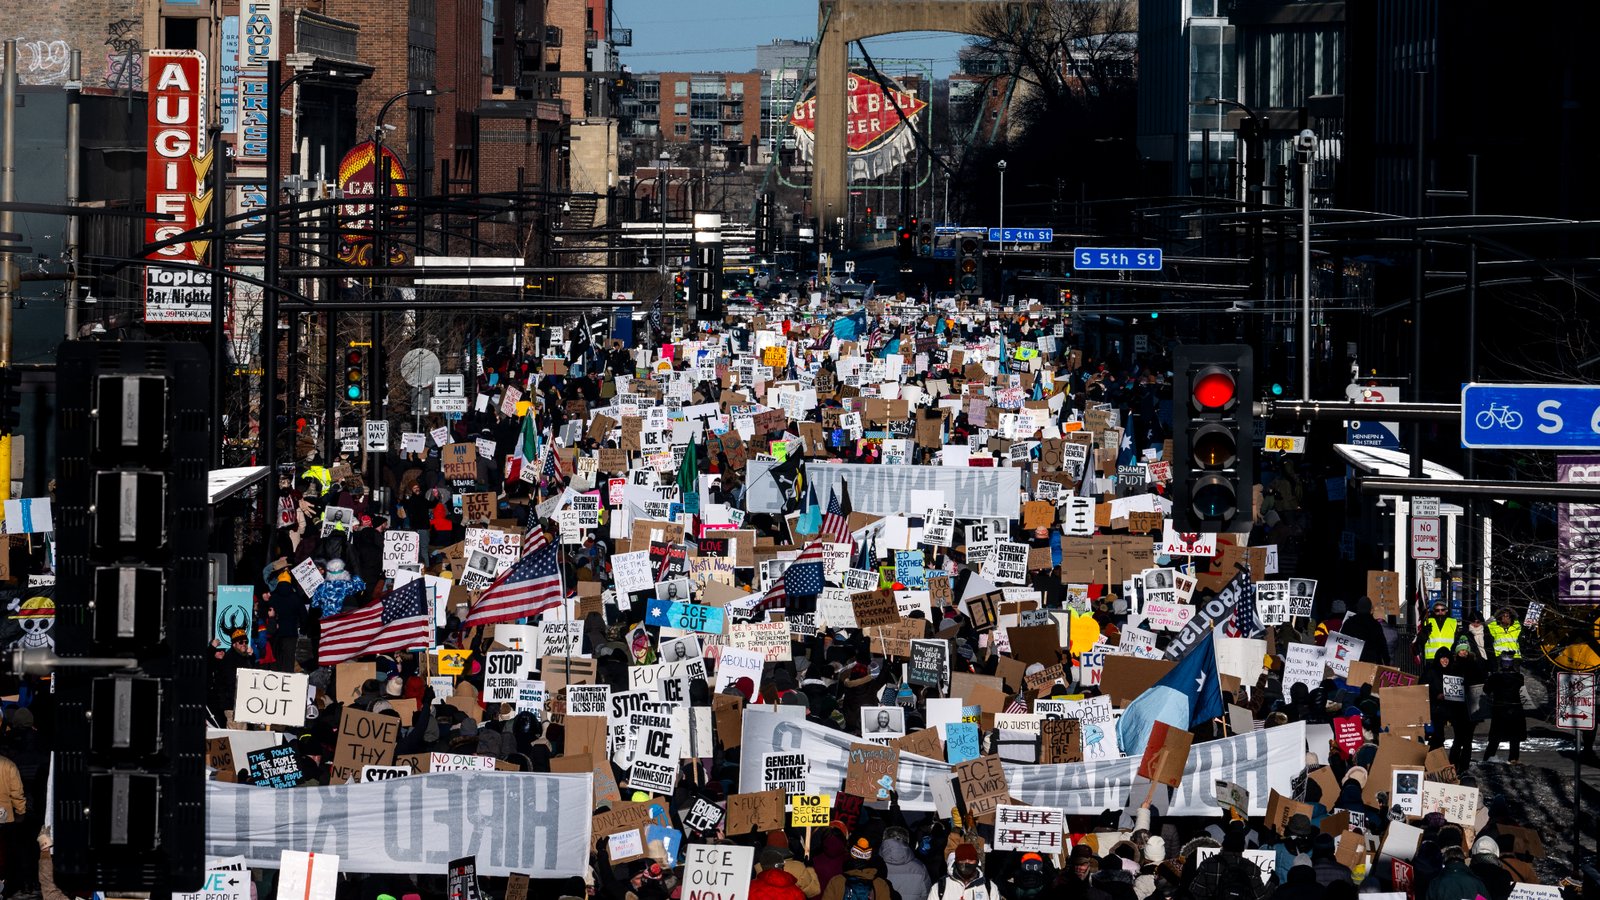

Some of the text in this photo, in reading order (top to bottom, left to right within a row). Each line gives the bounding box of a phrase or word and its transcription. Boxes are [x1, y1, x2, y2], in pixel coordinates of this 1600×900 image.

[868, 89, 918, 113] BELT
[241, 81, 268, 156] BRASS
[847, 119, 881, 134] EER
[155, 63, 191, 256] AUGIES
[1005, 230, 1050, 239] S 4th St
[1082, 253, 1156, 265] S 5th St
[1536, 399, 1564, 434] S
[368, 432, 386, 440] WAY
[645, 431, 658, 444] ICE
[444, 461, 475, 473] PRETTI
[634, 471, 649, 485] ICE
[466, 494, 489, 504] ICE
[468, 504, 489, 512] OUT
[660, 502, 669, 510] THE
[469, 511, 492, 520] NOW
[732, 511, 743, 519] ICE
[972, 525, 988, 542] ICE
[1420, 524, 1431, 532] NO
[385, 532, 409, 541] LOVE
[1414, 535, 1438, 543] STOPPING
[393, 542, 415, 552] GOD
[481, 544, 520, 556] WORST
[700, 541, 723, 550] LOVE
[999, 543, 1027, 554] GENERAL
[383, 552, 405, 561] LOVE
[616, 560, 647, 570] THE TIME
[690, 558, 711, 573] Kristi
[897, 559, 924, 567] RATHER
[869, 571, 879, 581] THE
[898, 569, 909, 577] BE
[997, 571, 1024, 580] JUSTICE
[928, 576, 949, 590] FUCK
[1257, 582, 1288, 591] PROTESTING
[826, 590, 845, 602] ICE
[931, 588, 948, 598] ICE
[1146, 592, 1175, 602] JUSTICE
[1258, 592, 1284, 600] ICE
[854, 599, 887, 609] AMERICA
[910, 602, 921, 610] YOU
[1268, 604, 1280, 613] NOT
[681, 604, 708, 618] ICE
[855, 606, 895, 618] DEMOCRACY
[542, 623, 569, 633] NEVER
[679, 617, 707, 630] OUT
[756, 623, 784, 631] TRAINED
[544, 635, 580, 645] AGAIN IS
[1336, 636, 1349, 645] ICE
[924, 651, 941, 659] ORDER
[488, 654, 523, 675] STOP
[721, 654, 762, 670] ABOLISH
[915, 661, 938, 671] TERROR
[250, 672, 292, 693] ICE
[487, 678, 496, 688] ICE
[1380, 671, 1416, 688] MELT
[492, 688, 514, 699] NOW!
[663, 679, 683, 702] ICE
[1445, 689, 1464, 697] LOVE
[571, 691, 607, 703] JONATHAN
[1078, 698, 1096, 706] THE
[246, 696, 293, 716] OUT
[572, 703, 606, 712] ROSS FOR
[1068, 704, 1110, 719] NORTH
[630, 714, 671, 729] GENERAL
[997, 721, 1009, 730] NO
[342, 714, 397, 746] LOVE
[645, 729, 673, 759] ICE
[1051, 734, 1070, 745] GET
[250, 746, 296, 763] THE POWER
[348, 743, 387, 766] THY
[258, 755, 297, 768] THE PEOPLE
[431, 753, 450, 764] NO
[453, 754, 479, 767] ONE
[482, 756, 494, 769] IS
[635, 760, 675, 773] OUT OF
[765, 754, 806, 768] GENERAL
[262, 764, 299, 779] STRONGER
[765, 766, 806, 781] STRIKE:
[957, 754, 1001, 783] ICE
[284, 770, 303, 781] PEOPLE
[632, 768, 673, 786] MINNESOTA
[275, 779, 297, 789] POWER
[797, 781, 806, 791] TO
[966, 778, 1006, 800] ALWAYS
[741, 797, 767, 811] FUCK
[800, 796, 821, 807] NO
[969, 794, 1008, 812] MELTS
[793, 806, 829, 815] SECRET
[793, 814, 829, 824] POLICE
[695, 849, 733, 866] ICE
[692, 870, 734, 887] OUT
[1521, 888, 1534, 896] Party
